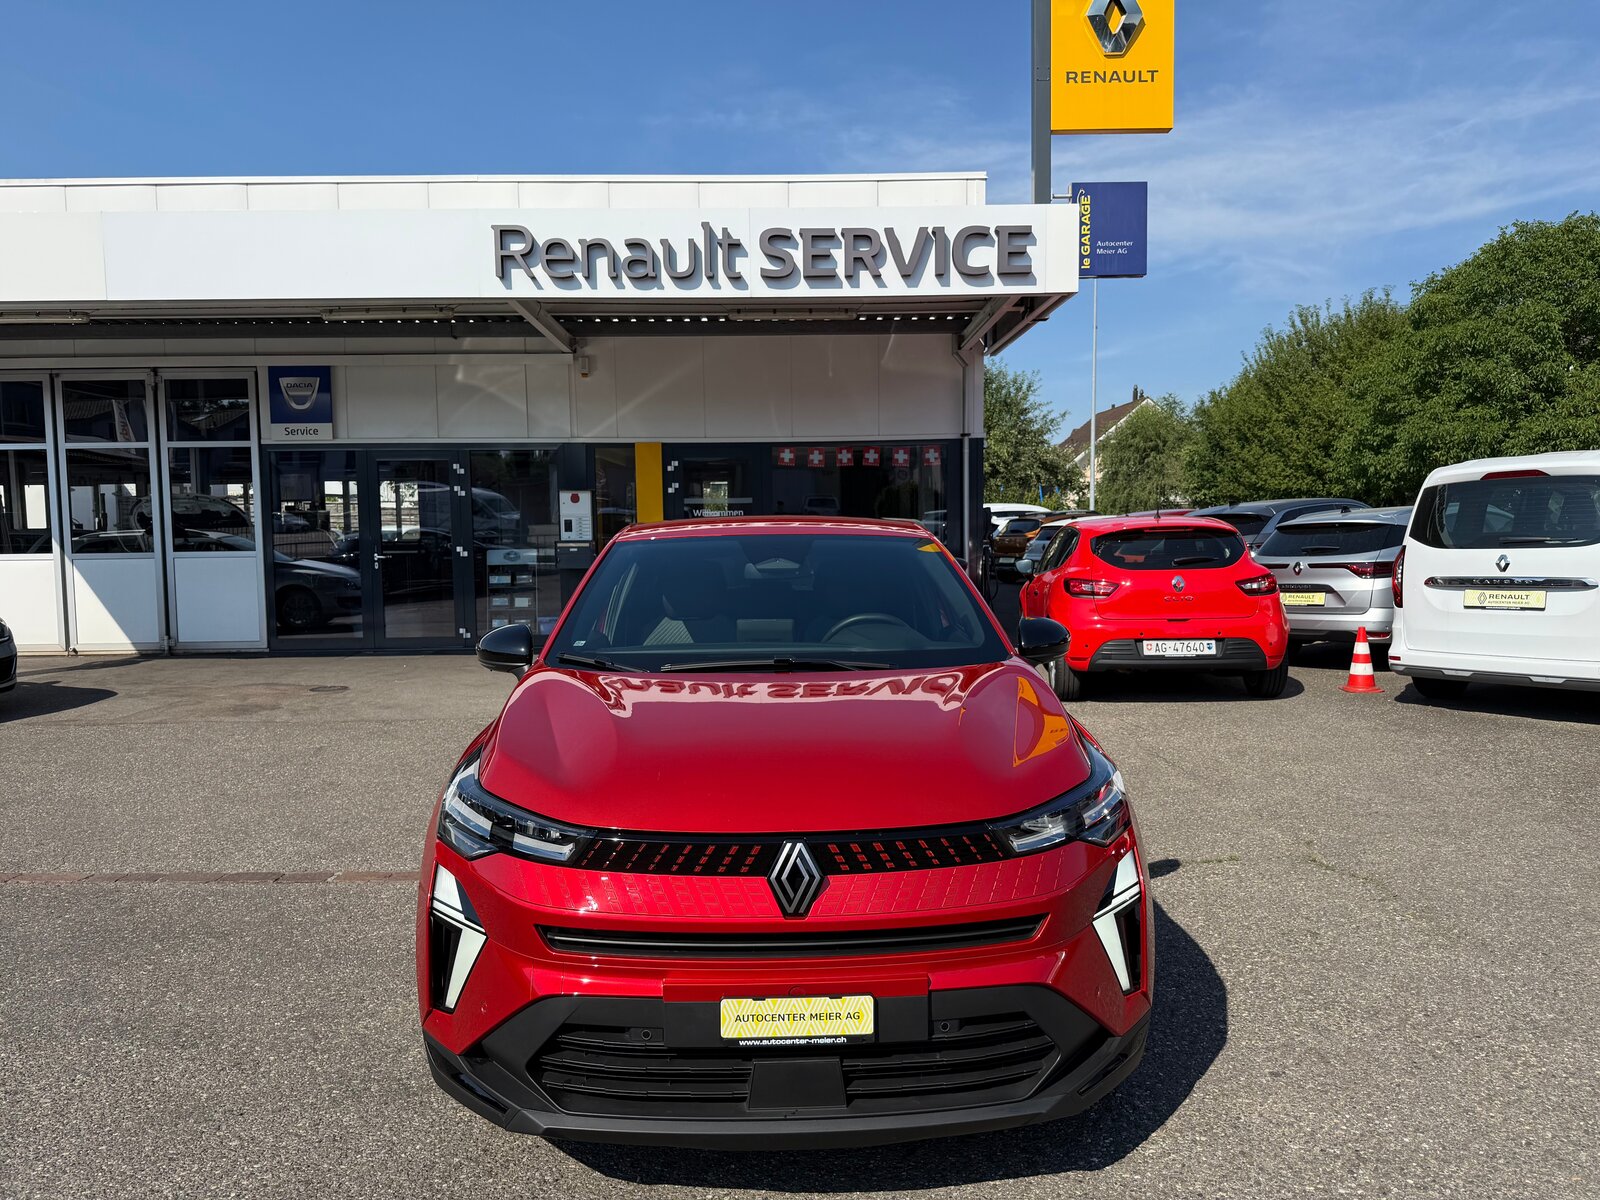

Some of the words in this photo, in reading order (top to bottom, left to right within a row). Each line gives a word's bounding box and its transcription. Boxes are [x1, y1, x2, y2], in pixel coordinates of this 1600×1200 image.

[1065, 70, 1159, 84] RENAULT
[1081, 195, 1091, 256] GARAGE
[491, 221, 743, 280] Renault
[759, 225, 1033, 279] SERVICE
[1081, 258, 1091, 269] le
[284, 426, 319, 436] Service
[734, 1013, 806, 1023] AUTOCENTER
[809, 1012, 842, 1021] MEIER
[845, 1011, 861, 1020] AG
[739, 1036, 847, 1046] www.autocenter-meier.ch
